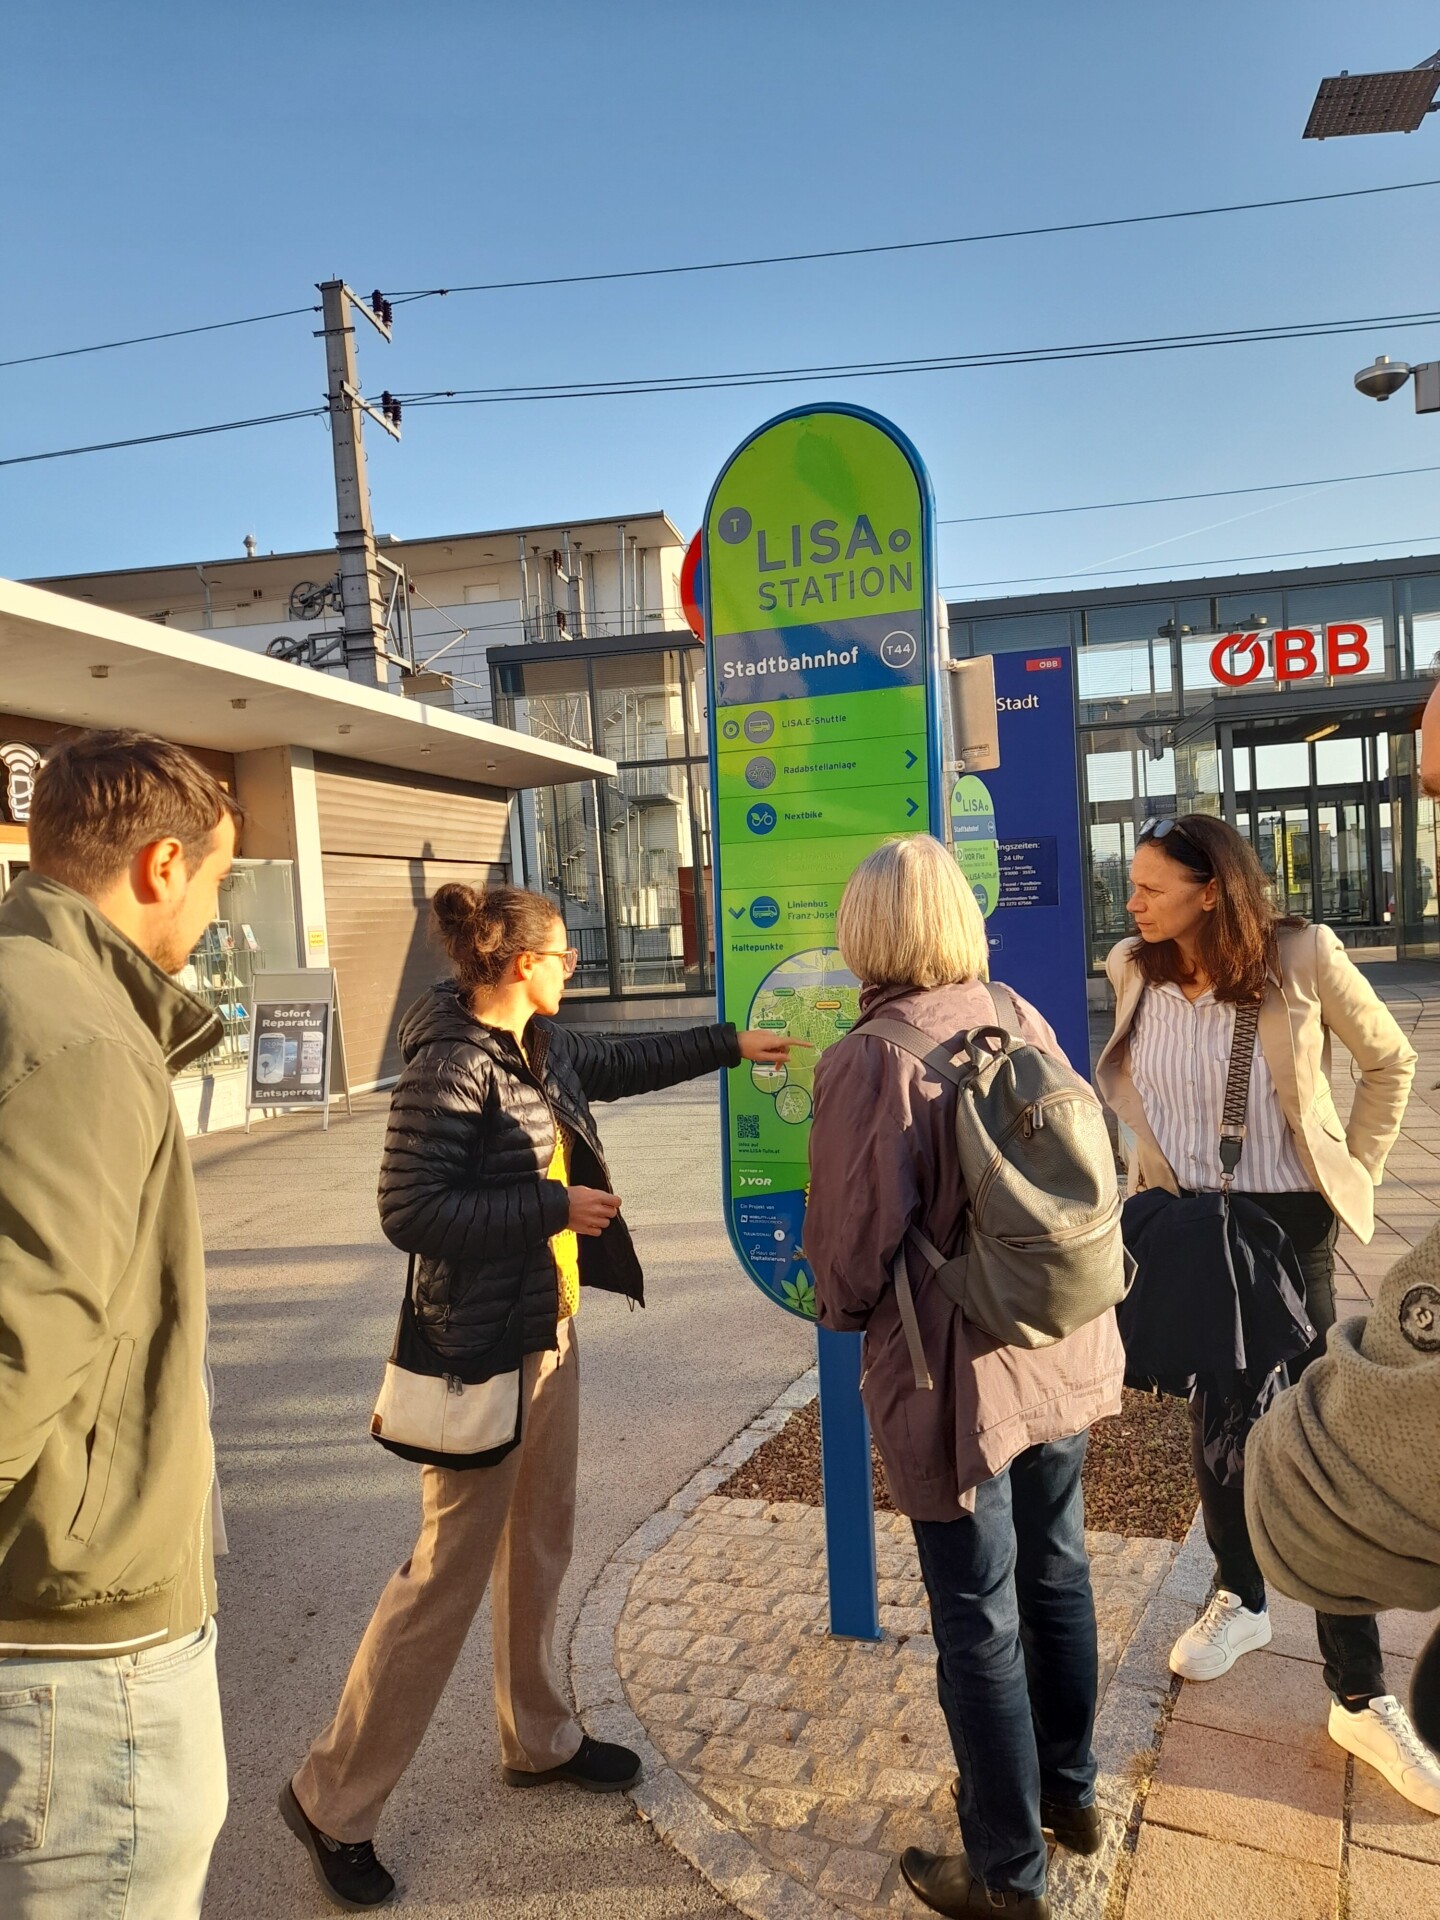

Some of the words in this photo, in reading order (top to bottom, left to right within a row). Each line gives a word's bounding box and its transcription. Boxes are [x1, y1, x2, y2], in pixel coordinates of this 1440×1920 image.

[758, 562, 913, 611] STATION
[886, 643, 911, 656] T44
[1209, 623, 1370, 687] ÖBB
[723, 646, 859, 680] Stadtbahnhof
[996, 694, 1040, 712] Stadt
[781, 714, 847, 729] LISA.E-Shuttle
[783, 760, 857, 775] Radabstellanlage
[784, 810, 823, 821] Nextbike
[999, 842, 1041, 852] ngszeiten:
[787, 900, 829, 909] Linienbus
[731, 943, 784, 953] Haltepunkte
[274, 1009, 311, 1018] Sofort
[262, 1018, 322, 1028] Reparatur
[255, 1089, 321, 1098] Entsperren
[747, 1177, 772, 1186] VOR
